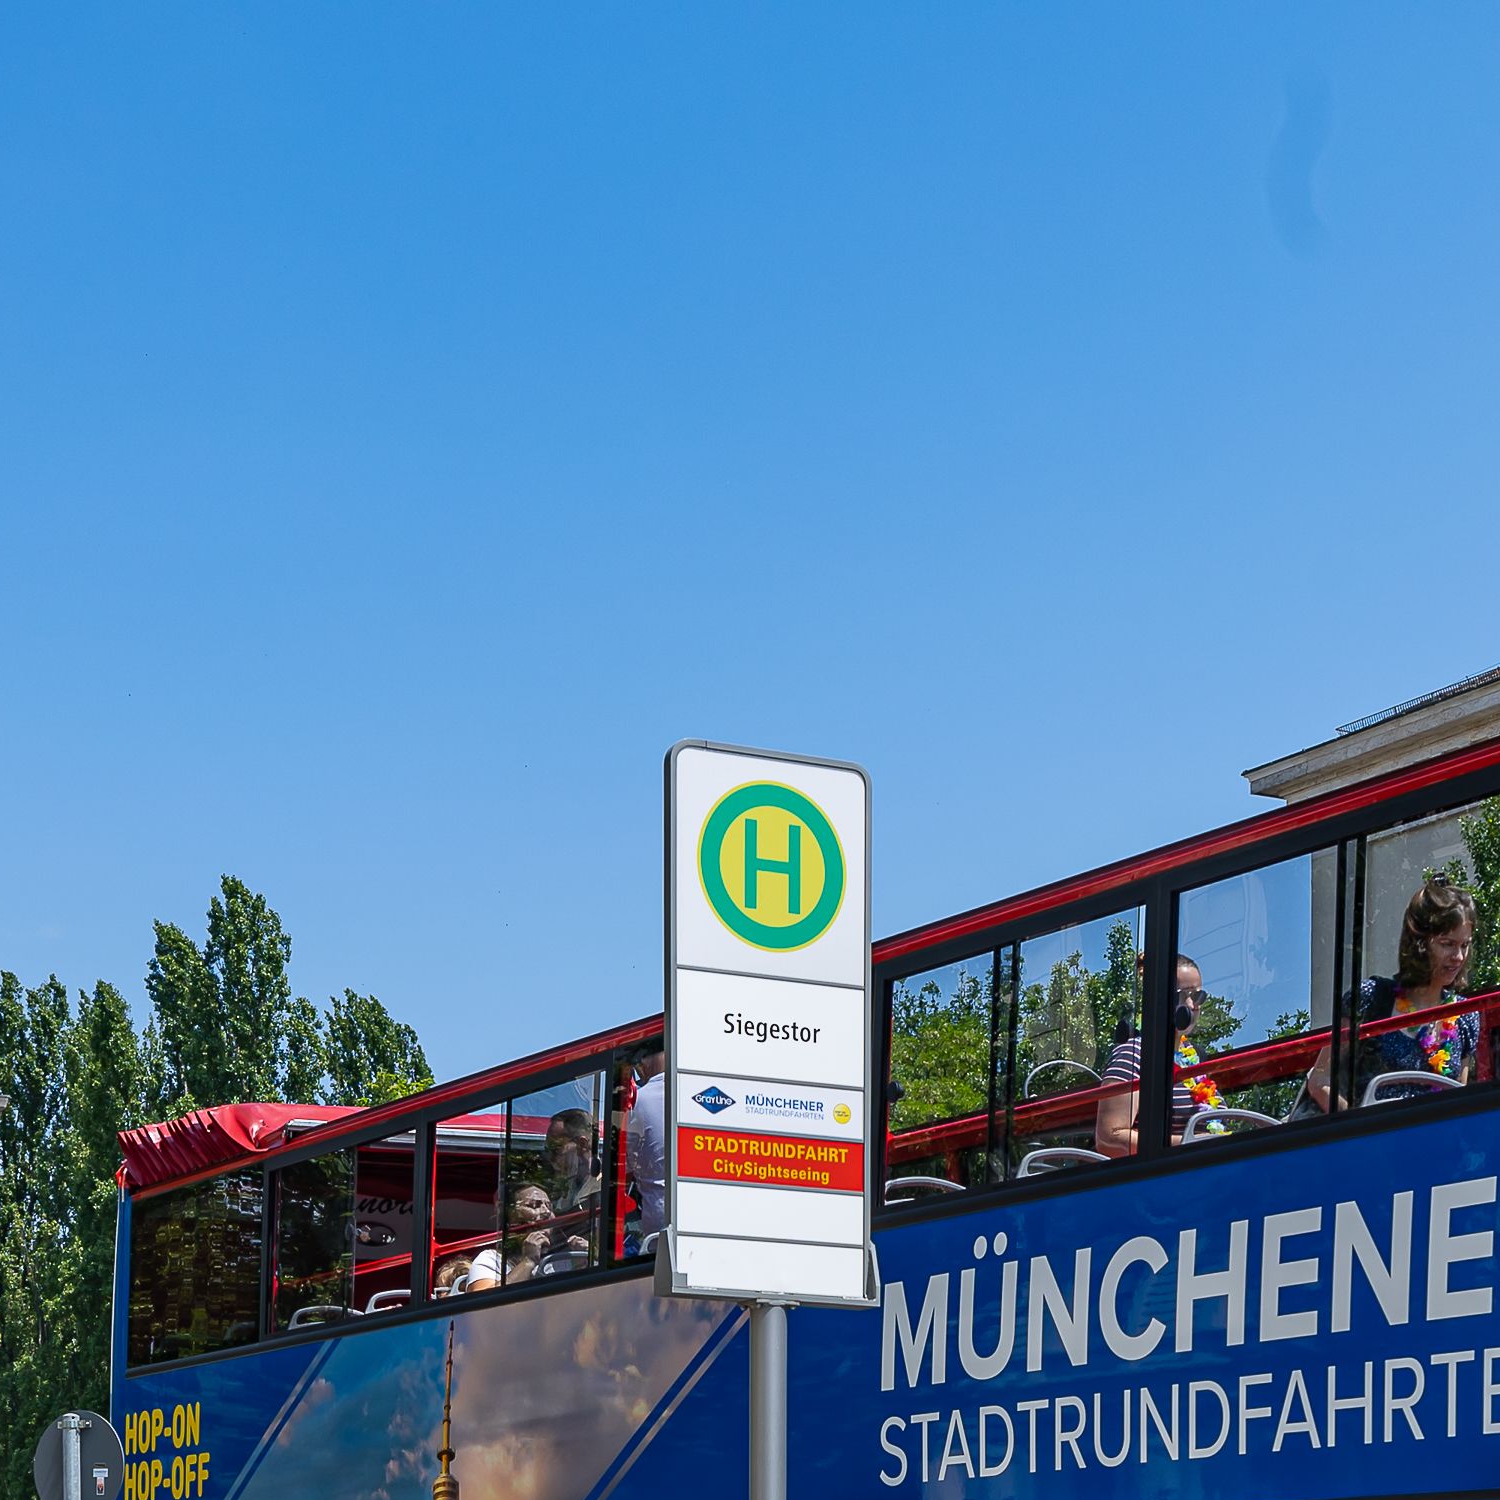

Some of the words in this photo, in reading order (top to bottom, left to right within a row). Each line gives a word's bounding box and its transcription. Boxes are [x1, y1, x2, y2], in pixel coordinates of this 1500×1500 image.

[744, 818, 800, 915] H
[724, 1012, 820, 1043] Siegestor
[745, 1093, 824, 1112] MÜNCHENER
[745, 1106, 824, 1120] STADTRUNDFAHRTEN
[694, 1135, 848, 1164] STADTRUNDFAHRT
[713, 1159, 830, 1185] CitySightseeing
[125, 1401, 200, 1456] HOP-ON
